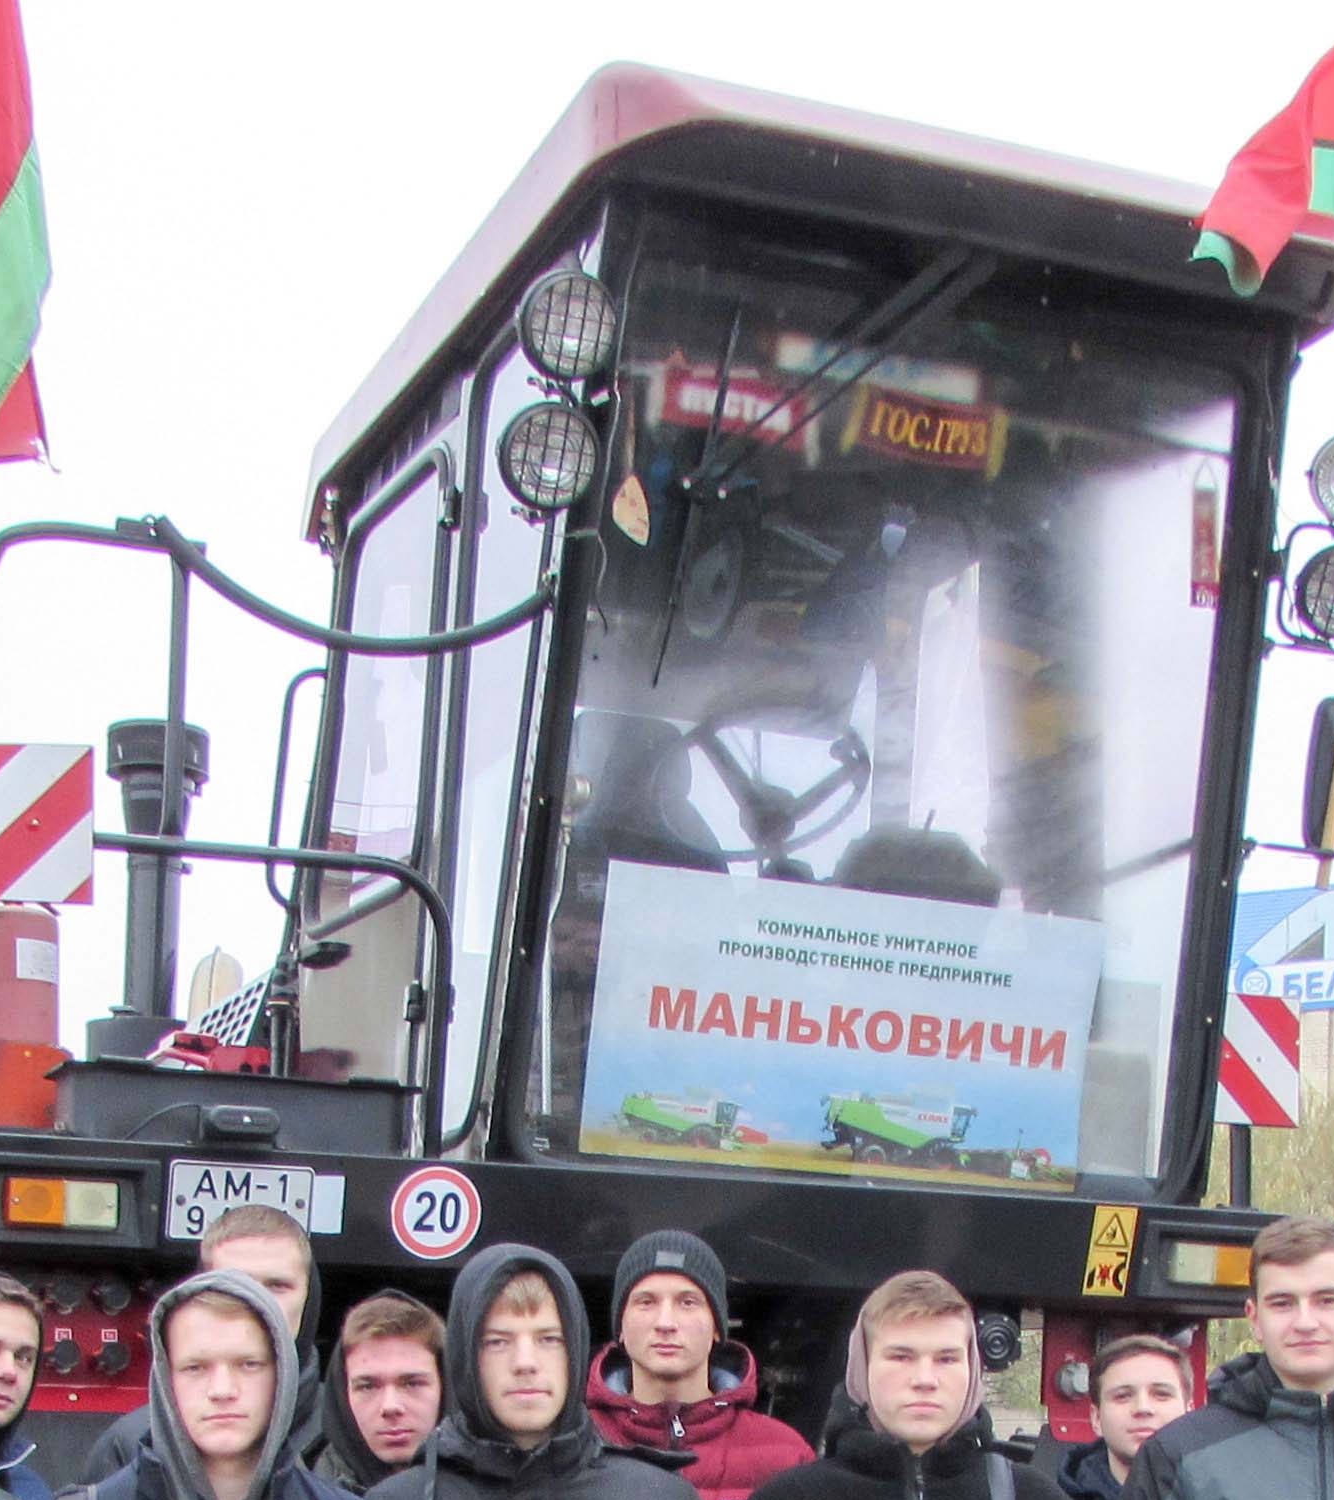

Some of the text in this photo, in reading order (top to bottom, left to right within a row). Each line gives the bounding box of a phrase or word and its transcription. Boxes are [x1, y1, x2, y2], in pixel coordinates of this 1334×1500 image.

[757, 919, 978, 960] КОМУНАЛЬНОЕ УНИТАРНОЕ
[718, 940, 1012, 988] ПРОИЗВОДСТВЕННОЕ ПРЕДПРИЯТИЕ
[648, 985, 1068, 1072] МАНЬКОВИЧИ
[413, 1191, 461, 1234] 20
